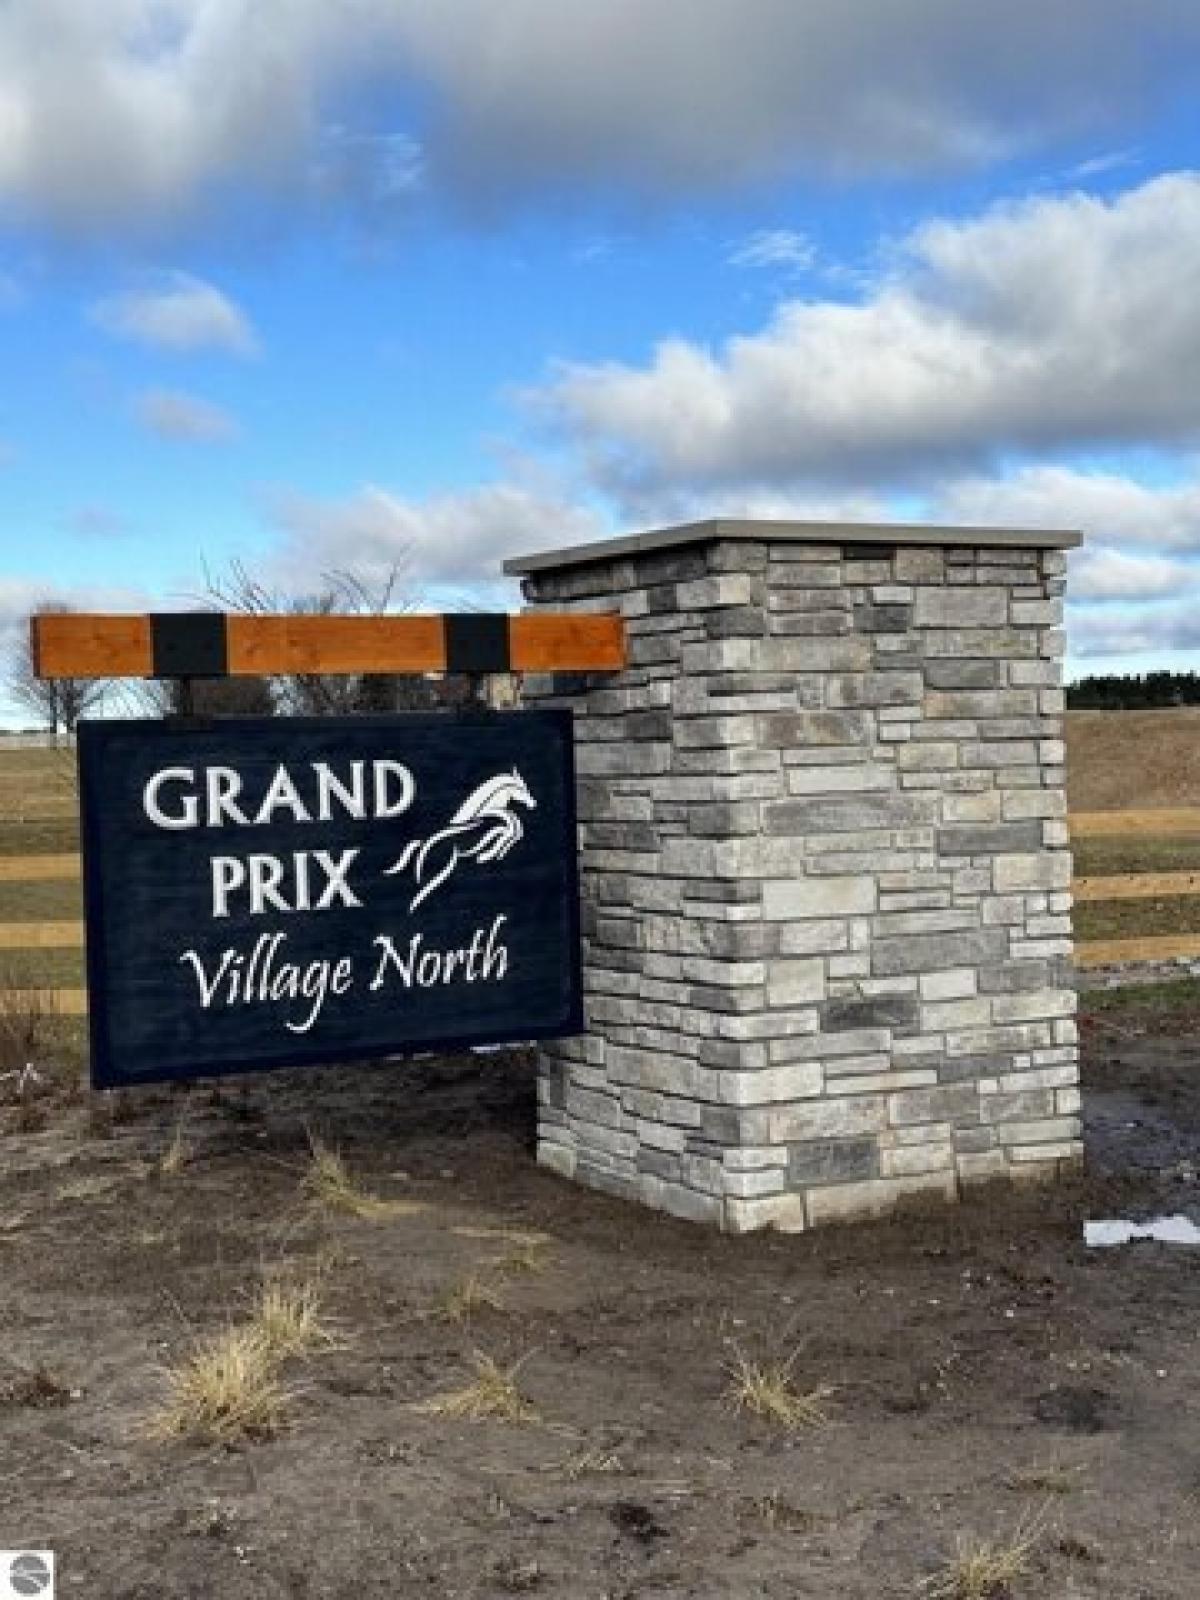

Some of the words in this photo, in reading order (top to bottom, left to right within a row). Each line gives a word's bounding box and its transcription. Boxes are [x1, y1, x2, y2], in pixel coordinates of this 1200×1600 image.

[143, 759, 416, 830] GRAND
[210, 849, 363, 918] PRIX
[180, 932, 353, 1034] Village
[369, 914, 508, 991] North
